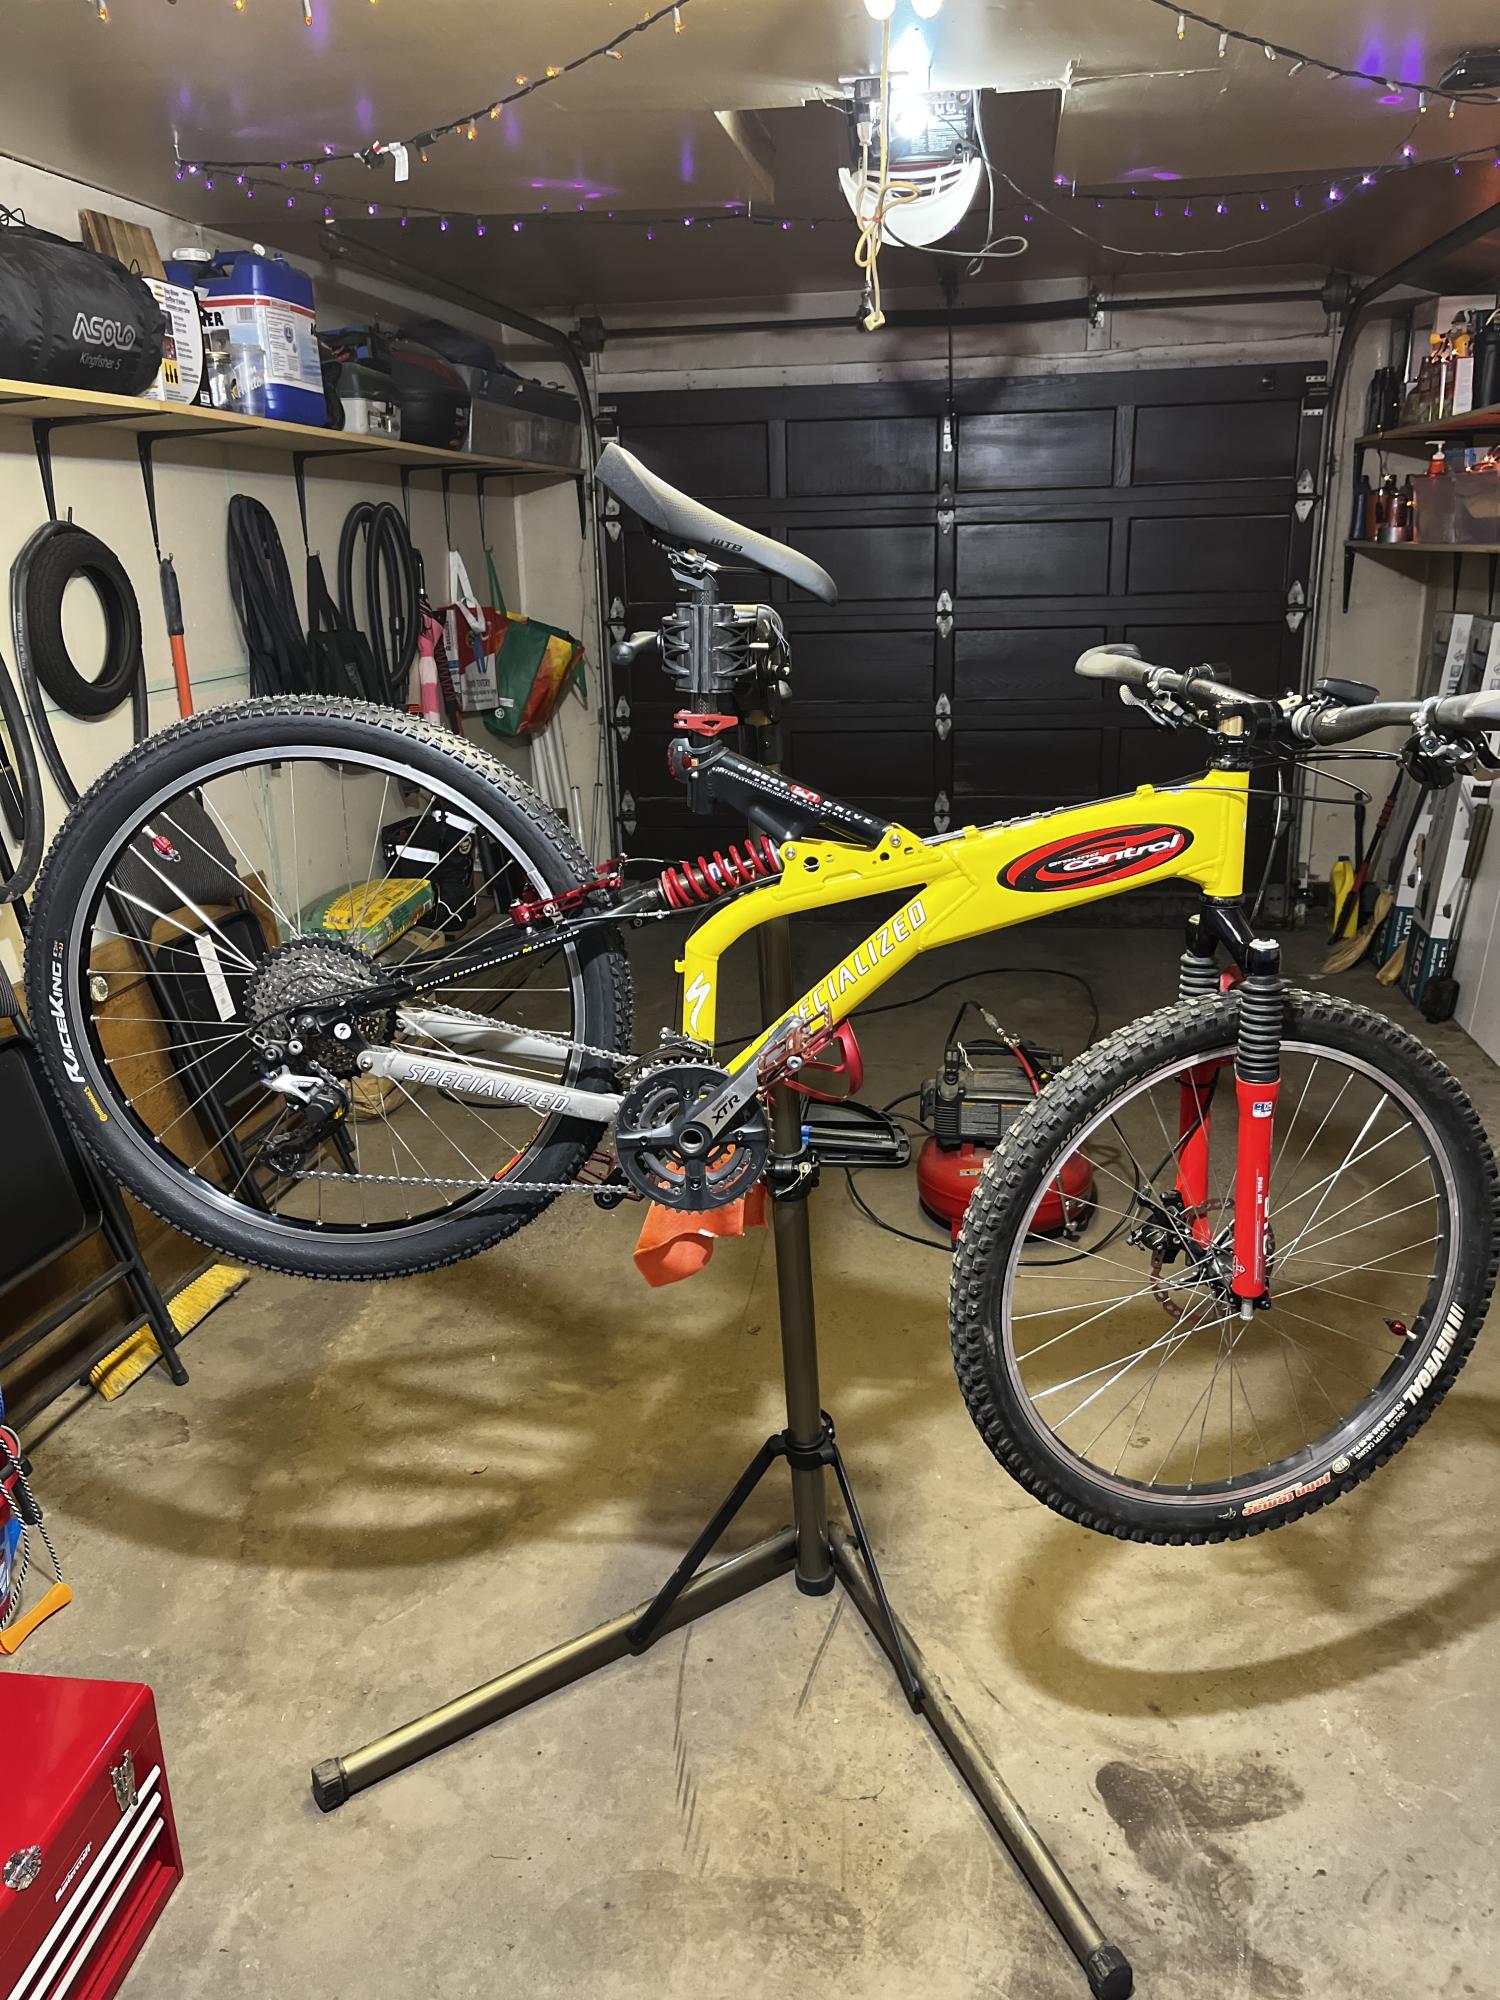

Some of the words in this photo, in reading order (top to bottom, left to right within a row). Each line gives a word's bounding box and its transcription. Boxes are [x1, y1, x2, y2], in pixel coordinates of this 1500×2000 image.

[73, 312, 136, 351] ASOLO
[737, 763, 788, 788] DIRECT
[822, 799, 872, 825] DRIVE
[1063, 834, 1181, 871] control
[768, 898, 927, 1037] ECIALIZED
[403, 1064, 571, 1112] SPECIALIZED
[711, 1095, 741, 1125] XTR
